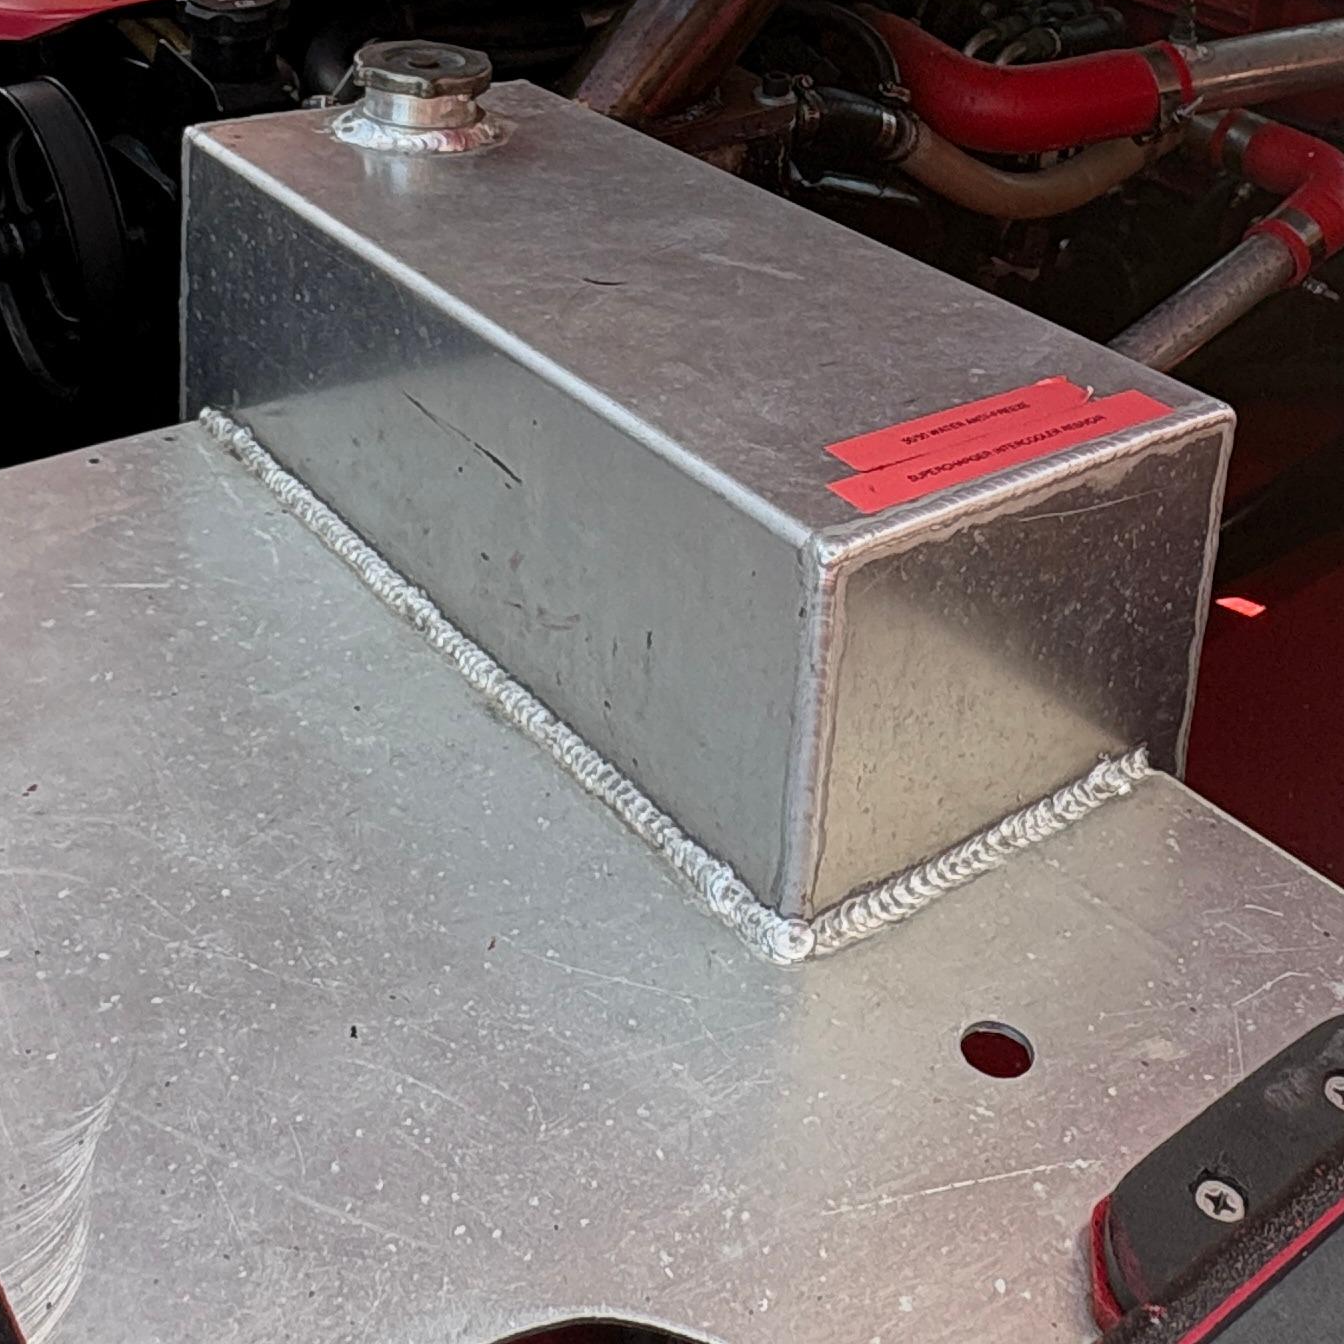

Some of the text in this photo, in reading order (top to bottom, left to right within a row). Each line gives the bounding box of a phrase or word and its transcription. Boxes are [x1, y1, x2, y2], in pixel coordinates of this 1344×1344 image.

[930, 421, 966, 436] WATER
[907, 451, 993, 482] SUPERCHARGER
[992, 428, 1063, 454] INTERCOOLER
